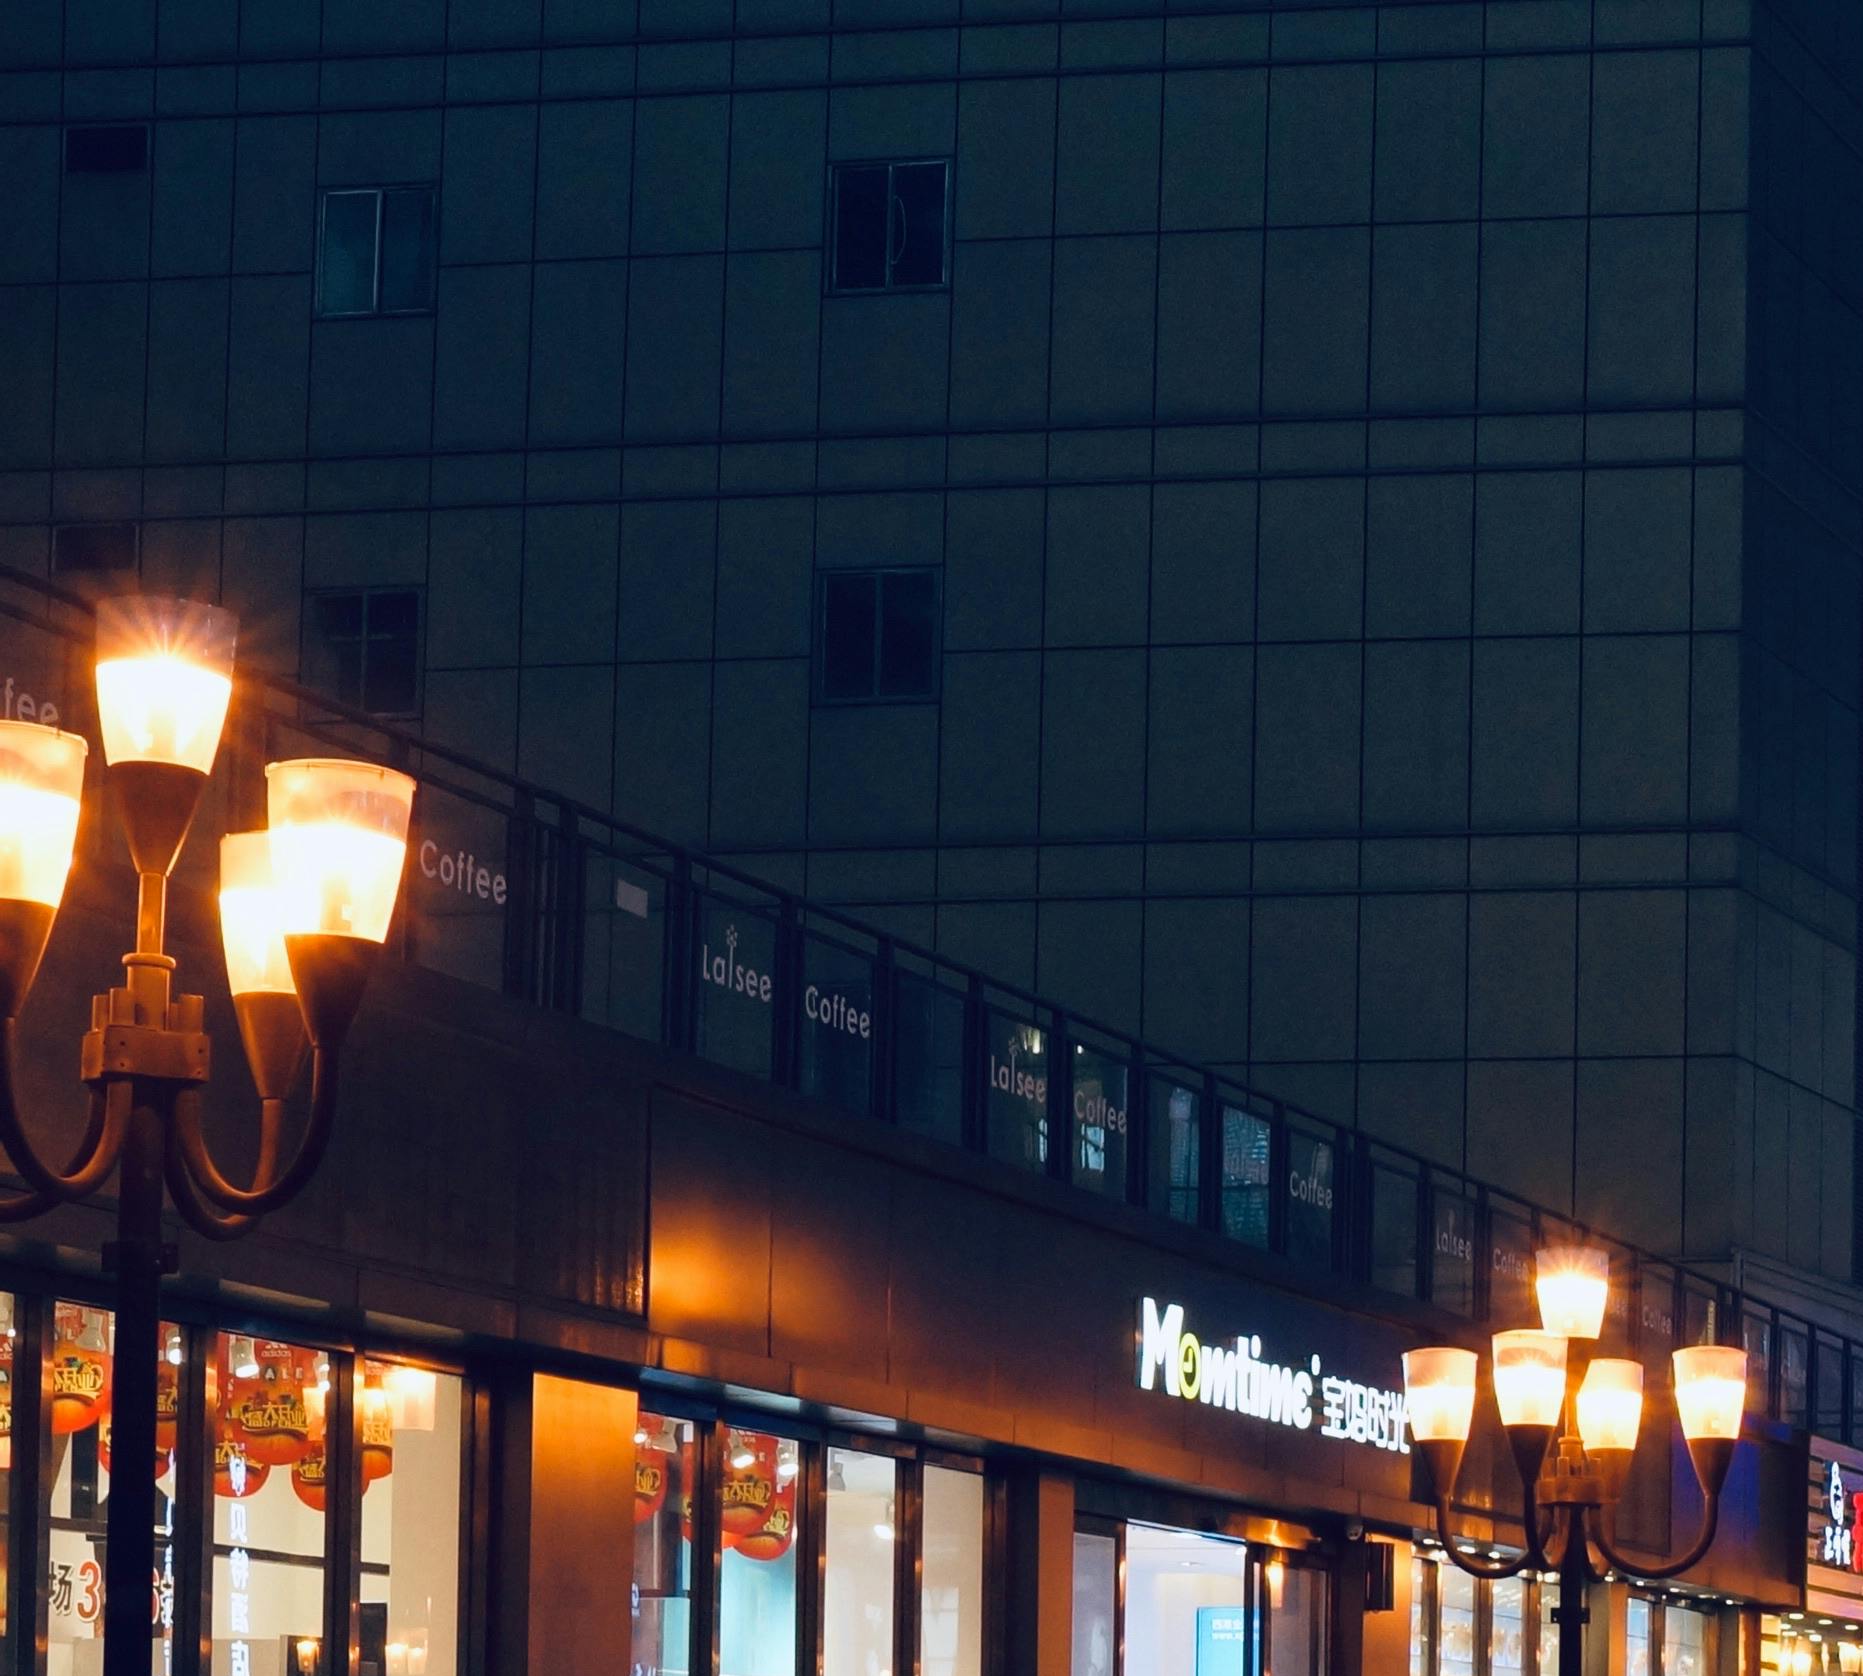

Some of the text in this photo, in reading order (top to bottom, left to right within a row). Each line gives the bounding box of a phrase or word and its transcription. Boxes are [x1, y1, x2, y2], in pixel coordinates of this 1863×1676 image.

[419, 839, 507, 905] Coffee
[804, 984, 872, 1039] Coffee
[1073, 1089, 1128, 1135] Coffee
[1289, 1170, 1333, 1210] Coffee
